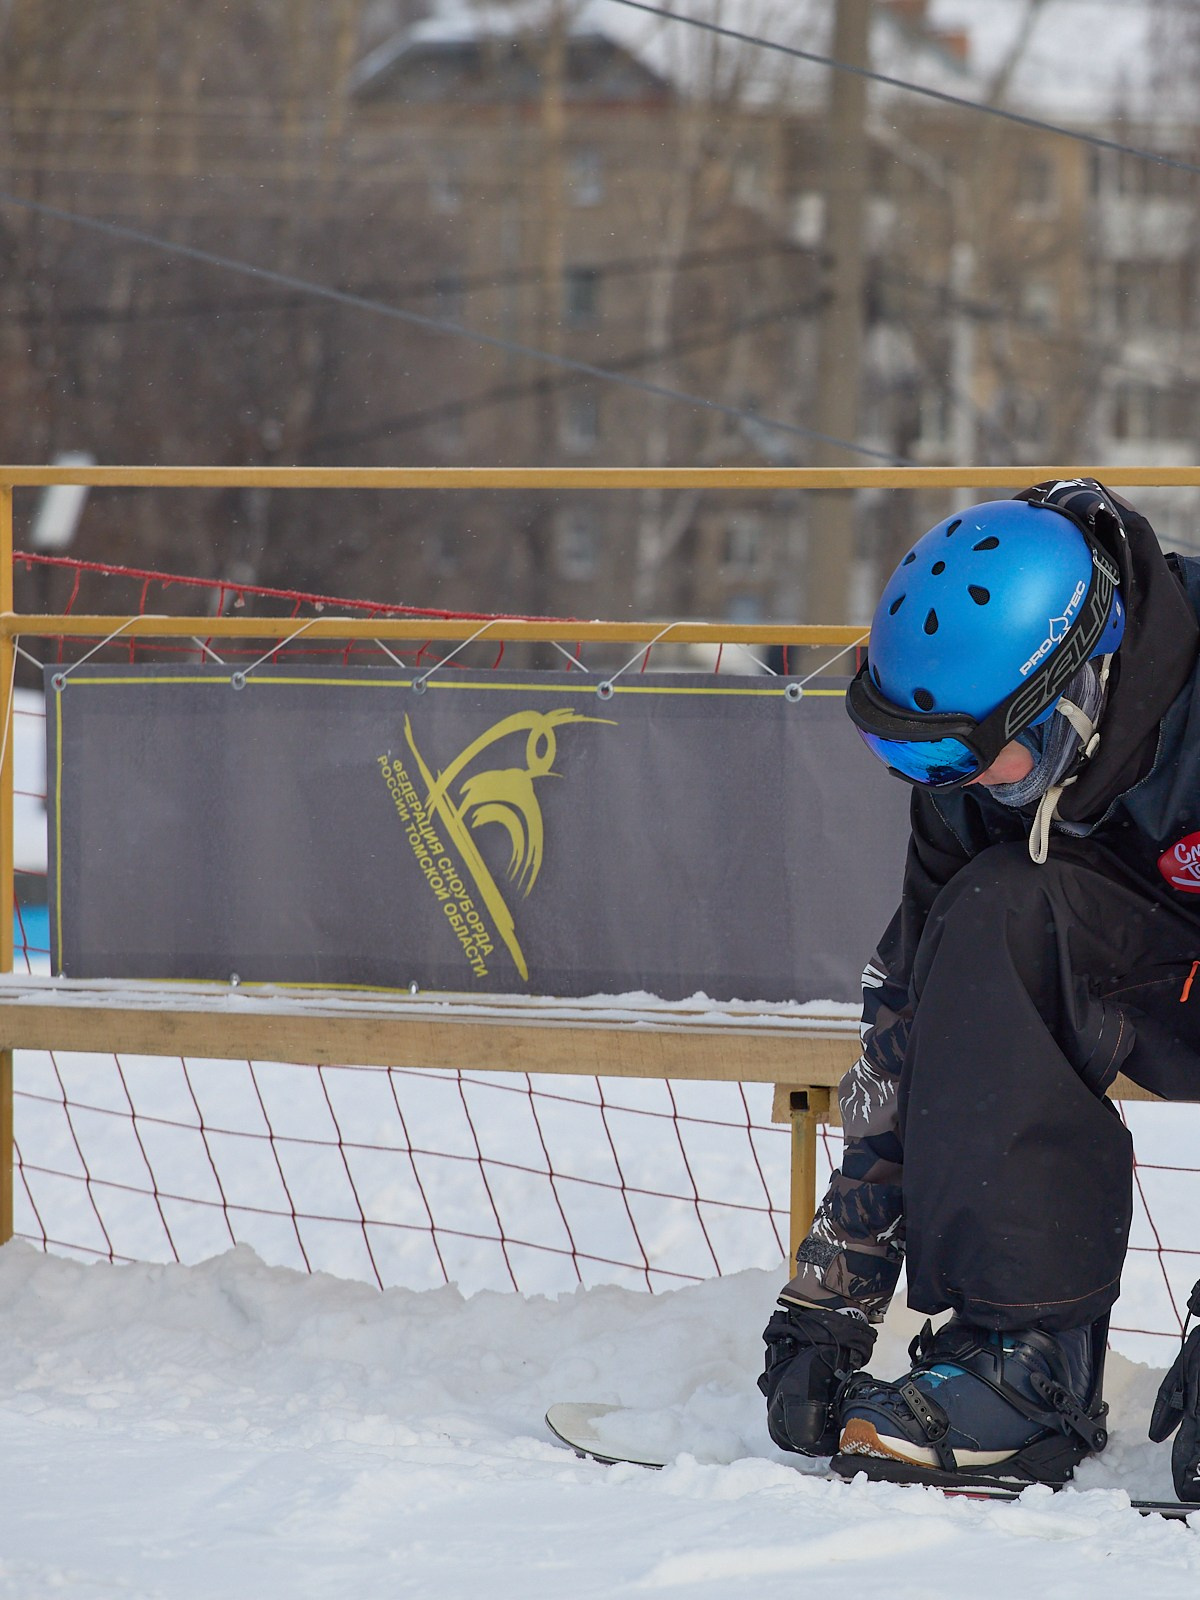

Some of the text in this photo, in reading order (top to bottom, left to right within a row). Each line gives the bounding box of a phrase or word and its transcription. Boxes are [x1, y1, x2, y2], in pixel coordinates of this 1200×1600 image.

[1019, 580, 1086, 675] PRO TEC
[377, 755, 489, 978] РОССИИ ТОМСКОЙ ОБЛАСТИ
[392, 759, 495, 957] ФЕДЕРАЦИЯ СНОУБОРДА
